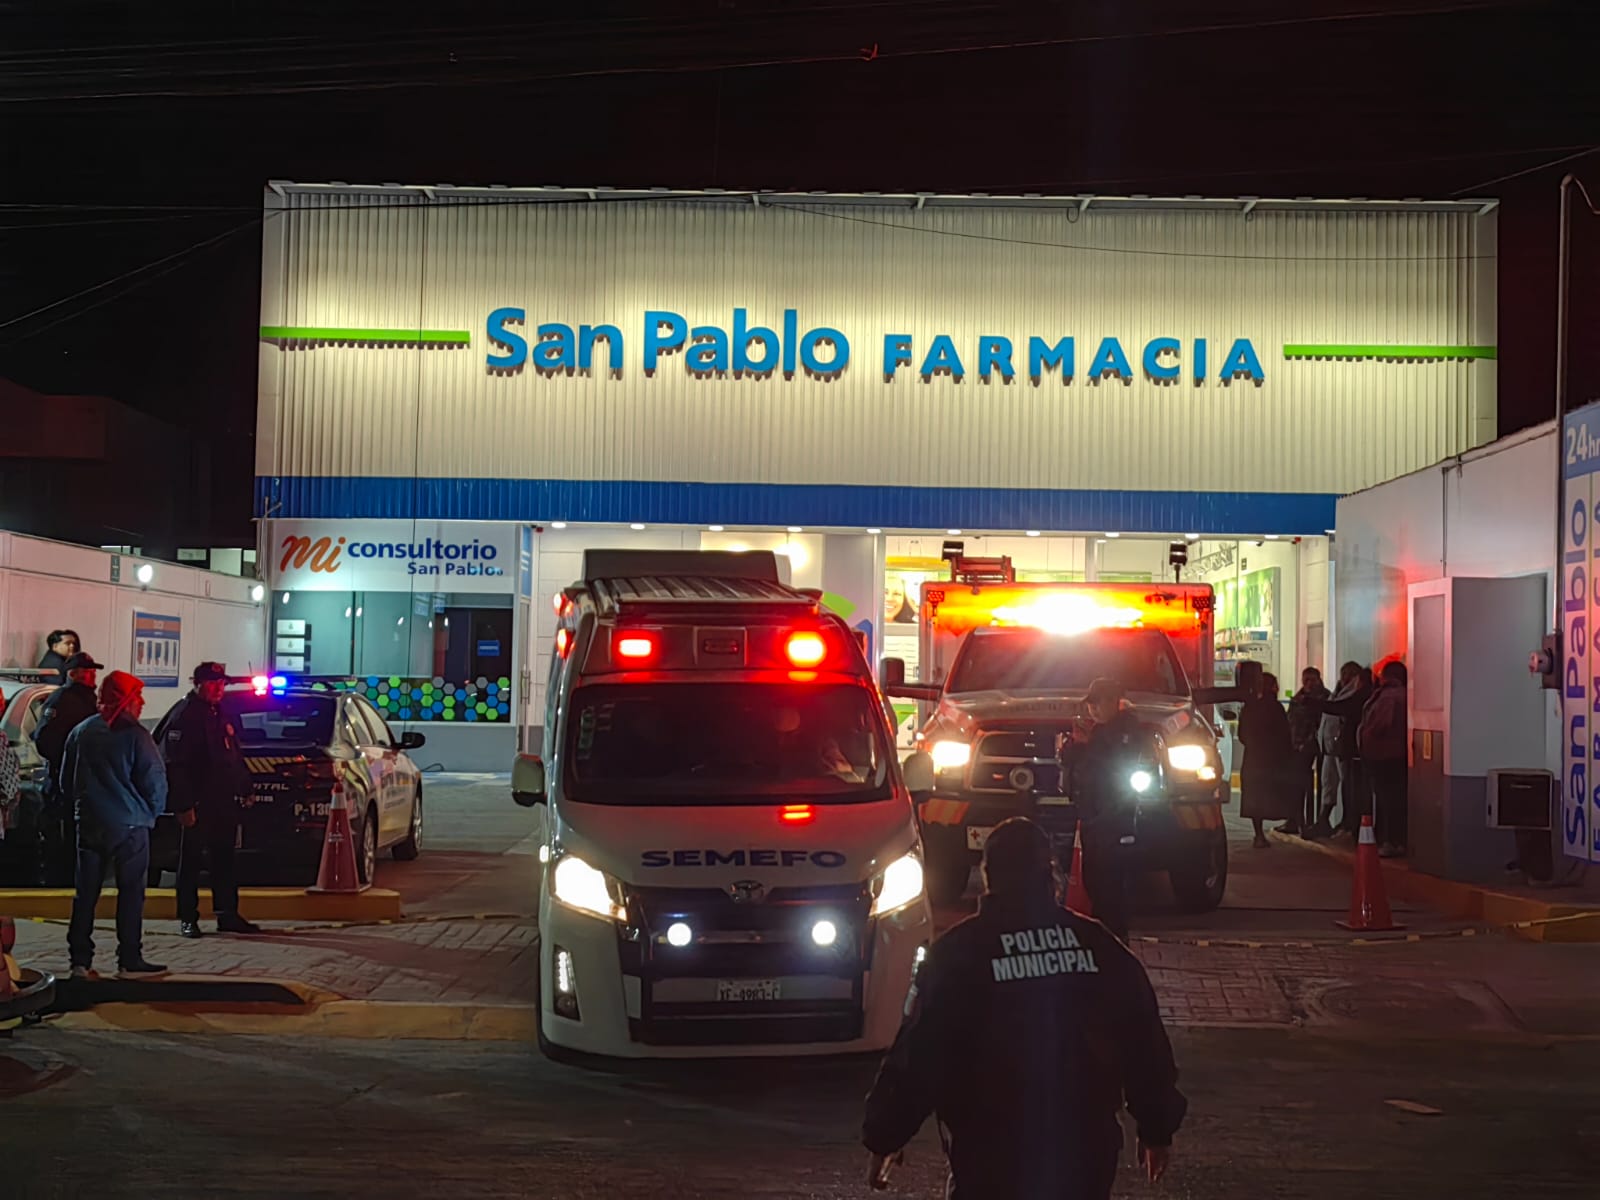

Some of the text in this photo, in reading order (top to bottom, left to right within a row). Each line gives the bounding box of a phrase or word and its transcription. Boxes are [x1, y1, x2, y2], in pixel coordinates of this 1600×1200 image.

[485, 306, 1265, 379] San Pablo FARMACIA
[347, 537, 497, 560] consultorio
[407, 561, 440, 575] San
[1565, 498, 1587, 847] San Pablo
[641, 850, 847, 868] SEMEFO
[992, 949, 1099, 981] MUNICIPAL
